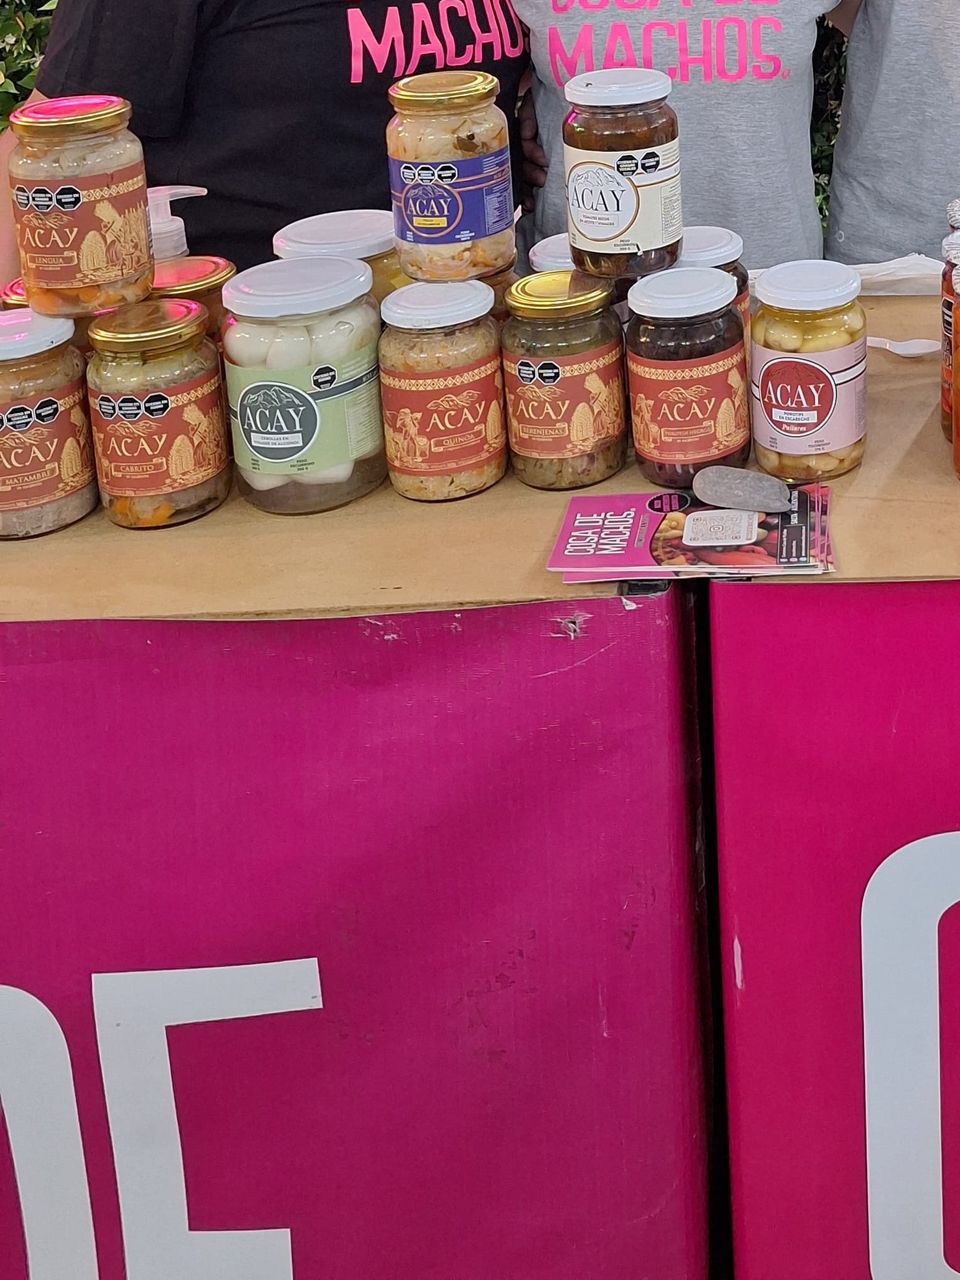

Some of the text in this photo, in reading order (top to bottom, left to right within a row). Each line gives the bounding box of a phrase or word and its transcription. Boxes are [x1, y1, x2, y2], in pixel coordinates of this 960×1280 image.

[407, 198, 452, 216] ACAY
[571, 186, 627, 212] ACAY
[23, 228, 79, 248] ACAY
[764, 381, 825, 408] ACAY
[243, 406, 307, 433] ACAY
[426, 400, 486, 432] ACAY
[516, 399, 570, 420] ACAY
[657, 397, 716, 421] ACAY
[107, 434, 167, 456] ACAY
[564, 512, 605, 556] COSA DE
